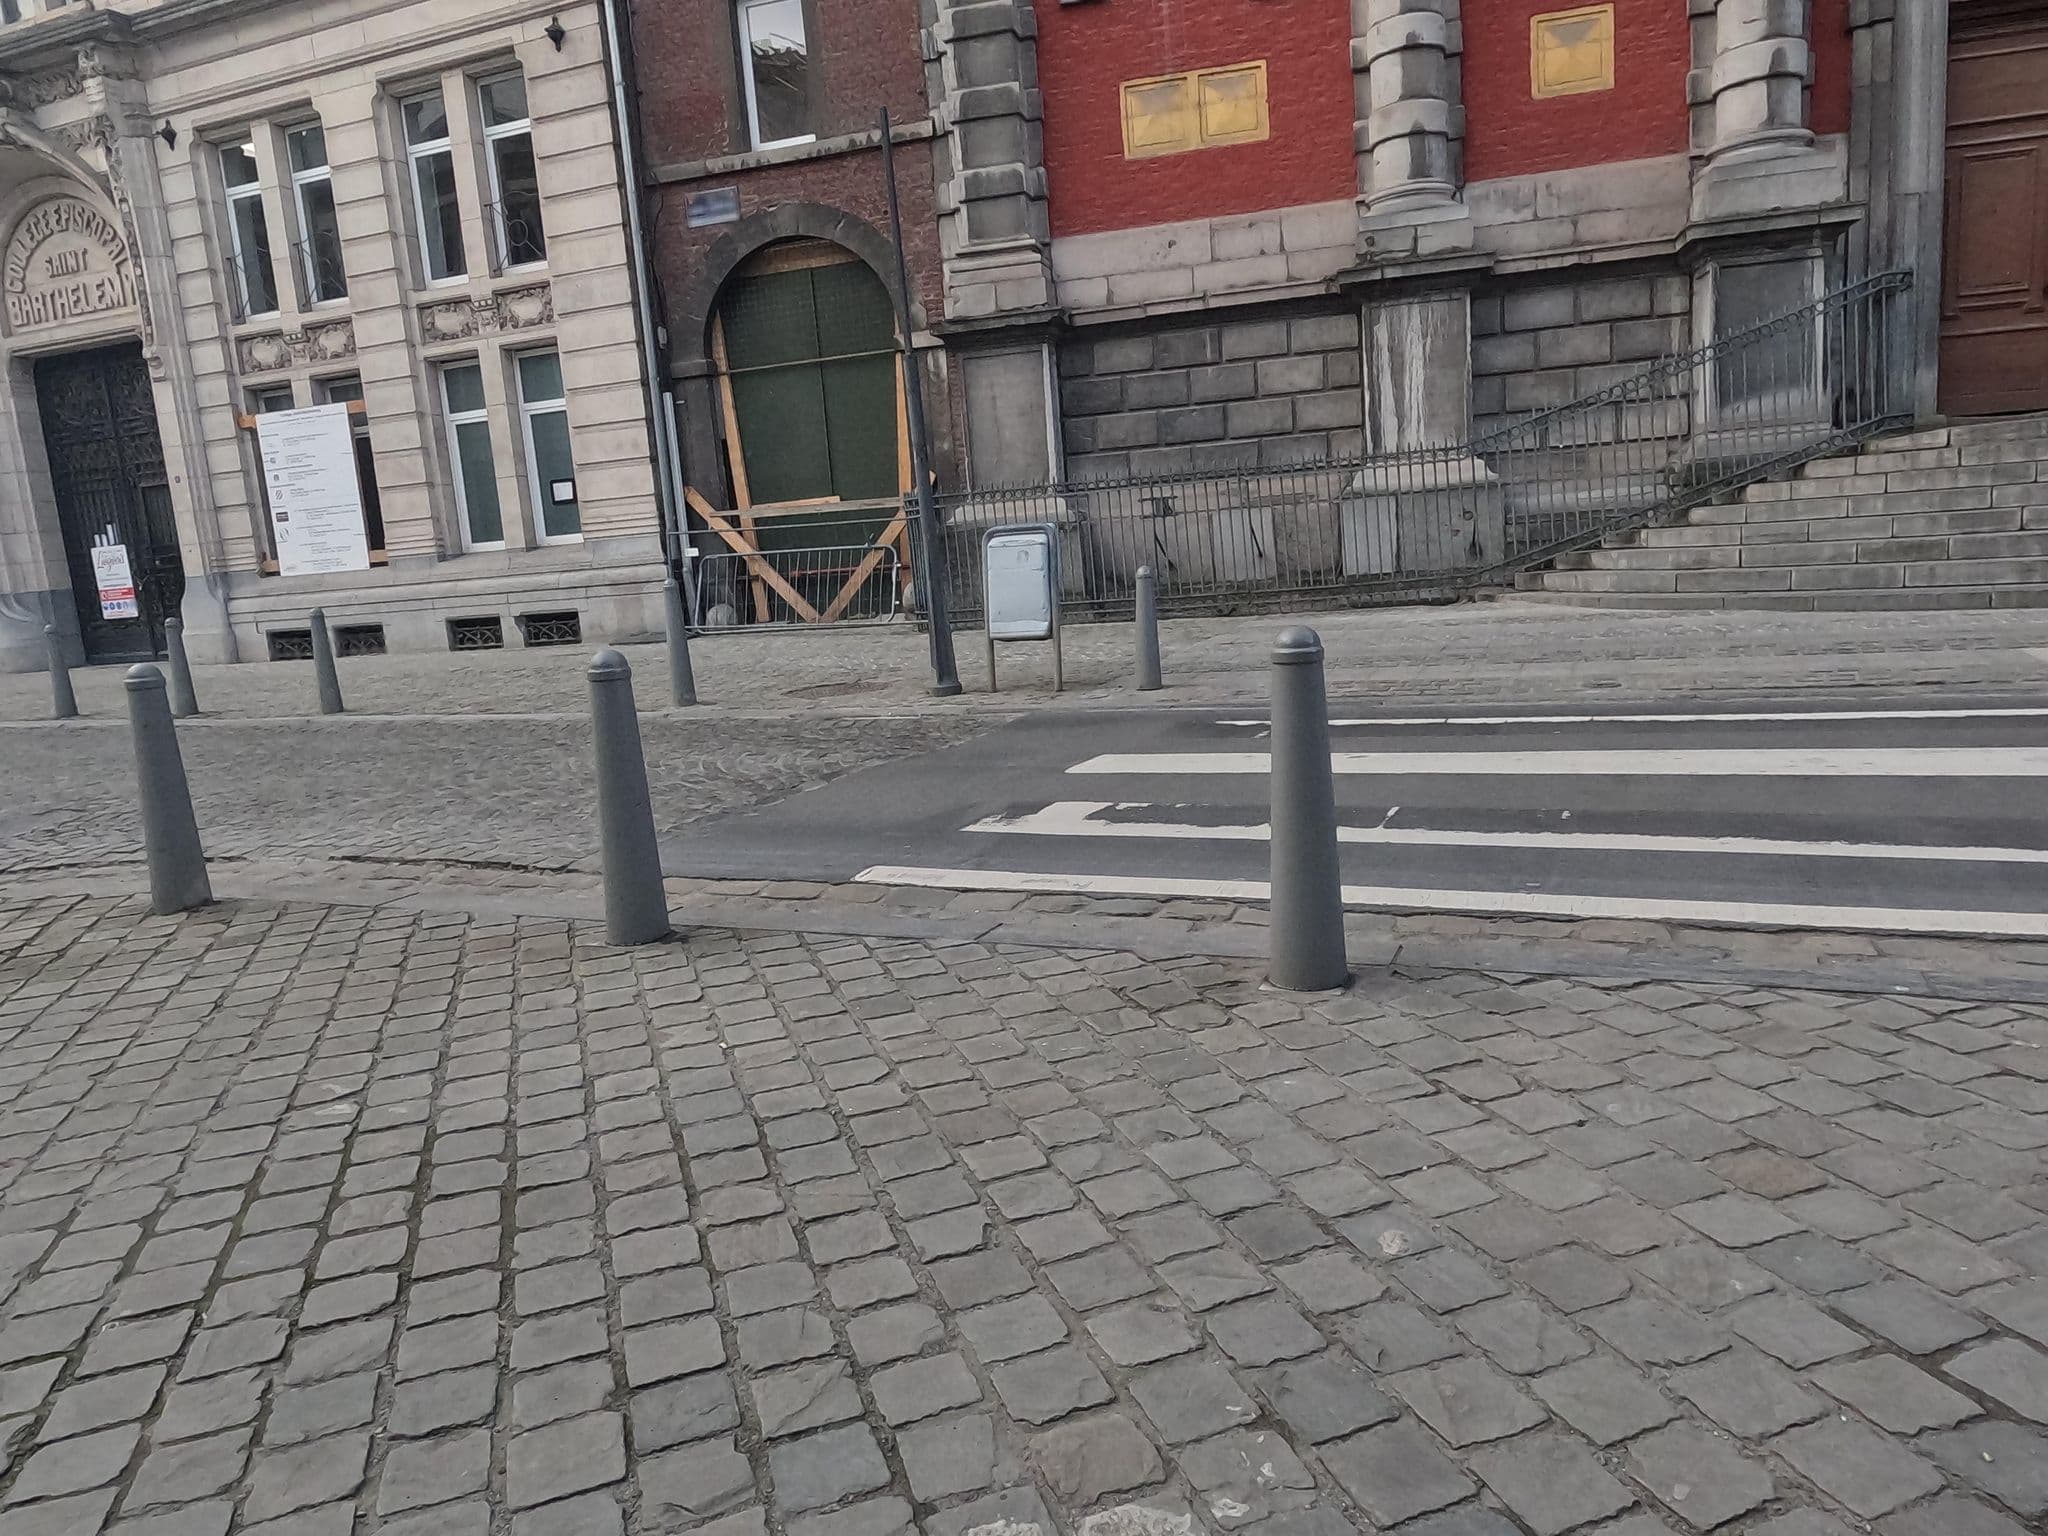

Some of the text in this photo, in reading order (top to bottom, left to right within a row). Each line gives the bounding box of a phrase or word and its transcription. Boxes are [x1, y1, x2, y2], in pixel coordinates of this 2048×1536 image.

[8, 203, 128, 293] COLLEGE EPISCOPAL
[45, 248, 88, 278] SAINT
[8, 272, 136, 327] BARTHELEMY
